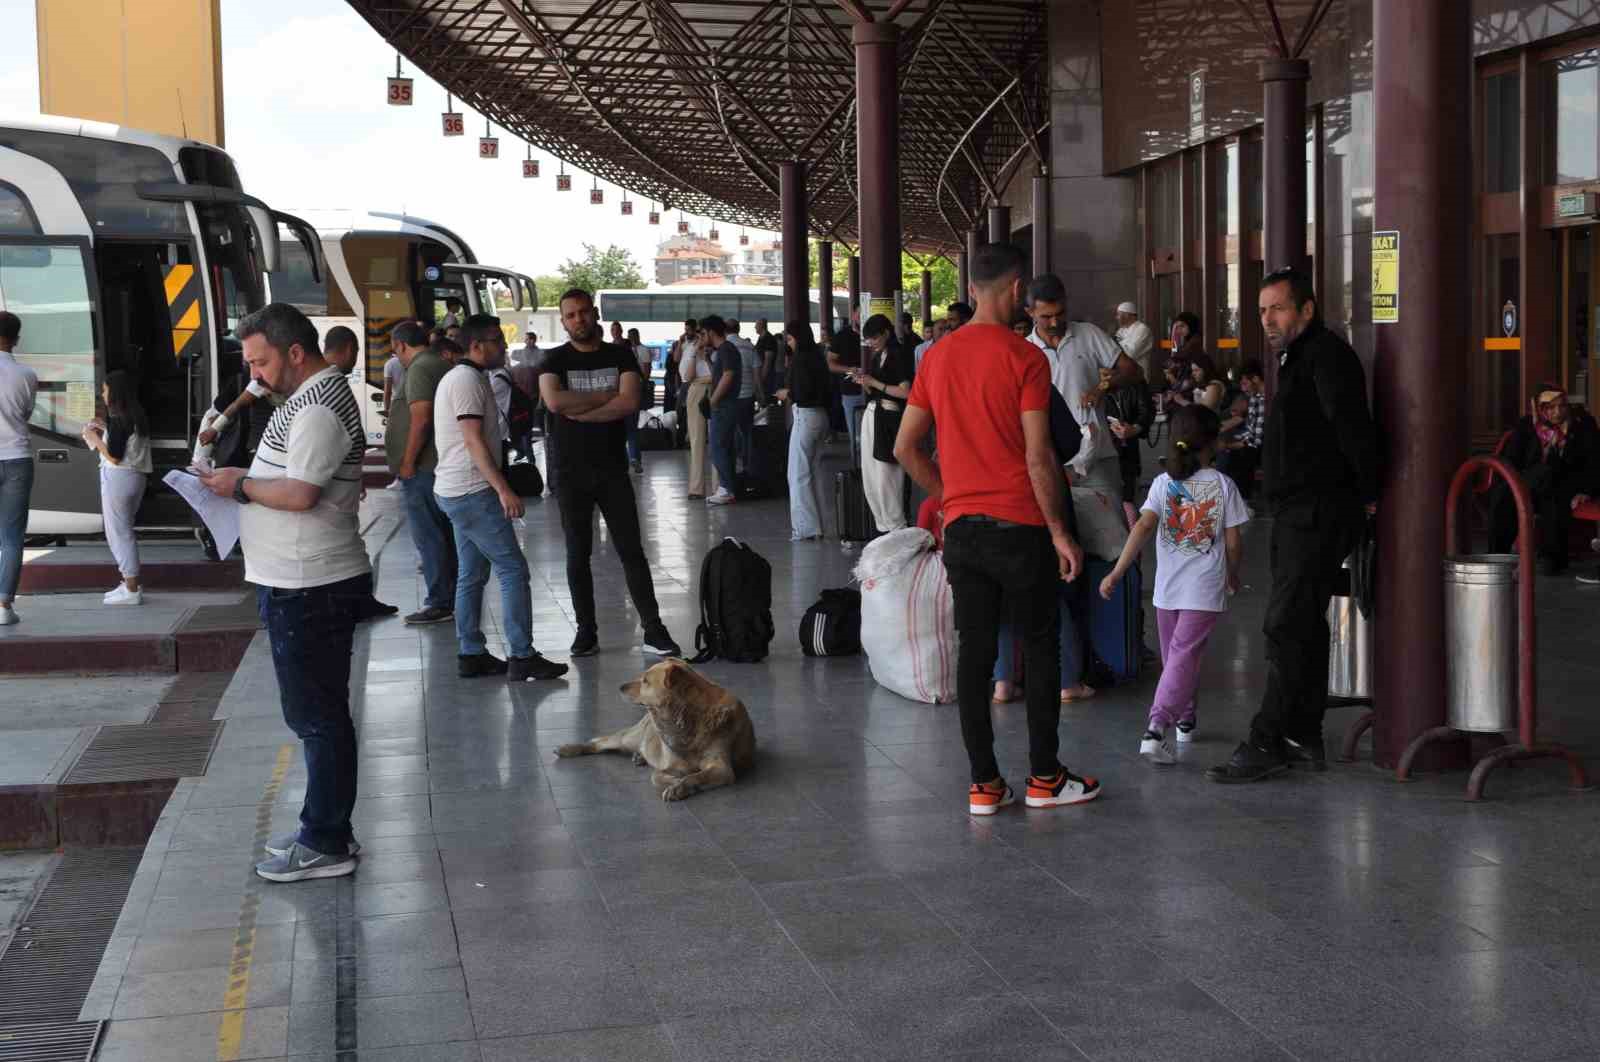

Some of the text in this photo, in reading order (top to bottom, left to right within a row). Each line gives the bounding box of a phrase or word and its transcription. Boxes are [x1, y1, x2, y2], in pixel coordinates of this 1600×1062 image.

[391, 85, 411, 100] 35
[444, 118, 463, 132] 36
[481, 143, 497, 155] 37
[524, 164, 539, 176] 38
[558, 179, 571, 190] 39
[1372, 296, 1393, 305] TION
